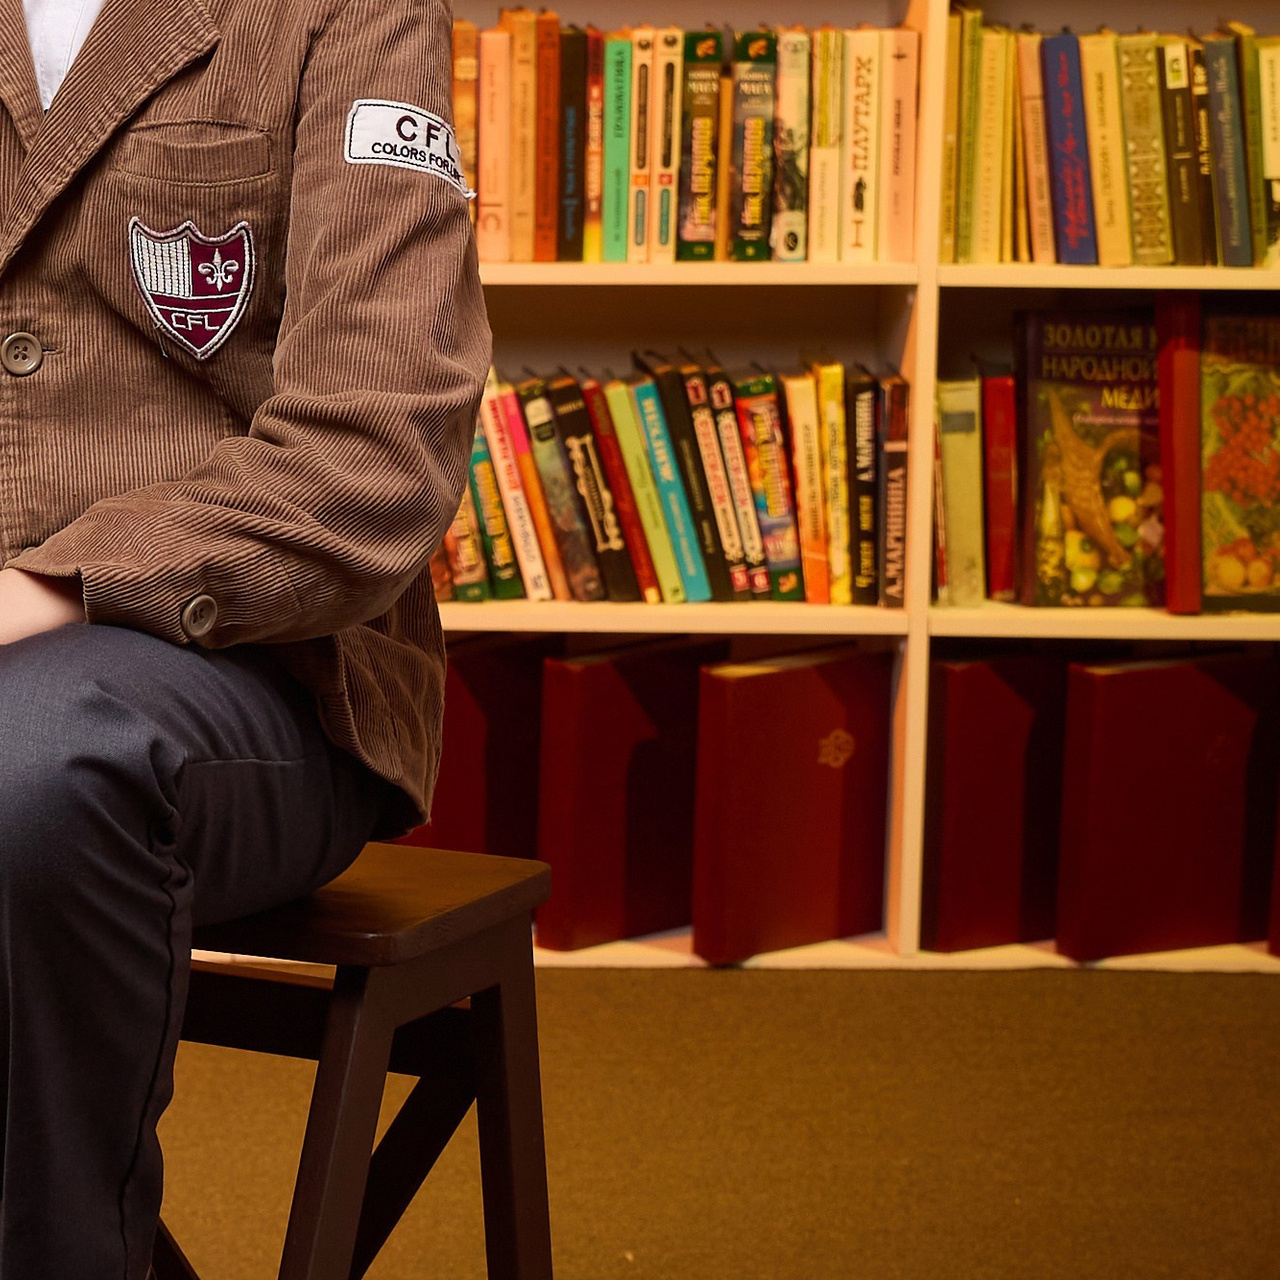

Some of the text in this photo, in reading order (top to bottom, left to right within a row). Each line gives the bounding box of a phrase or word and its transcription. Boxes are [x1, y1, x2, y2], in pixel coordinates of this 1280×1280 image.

[851, 56, 873, 172] ПЛУТАРХ
[395, 115, 456, 163] CFL
[371, 142, 426, 163] COLORS
[170, 312, 221, 332] CFL
[1043, 324, 1144, 348] ЗОЛОТАЯ
[1042, 356, 1158, 380] НАРОДНОЙ
[1101, 386, 1160, 410] МЕДИ
